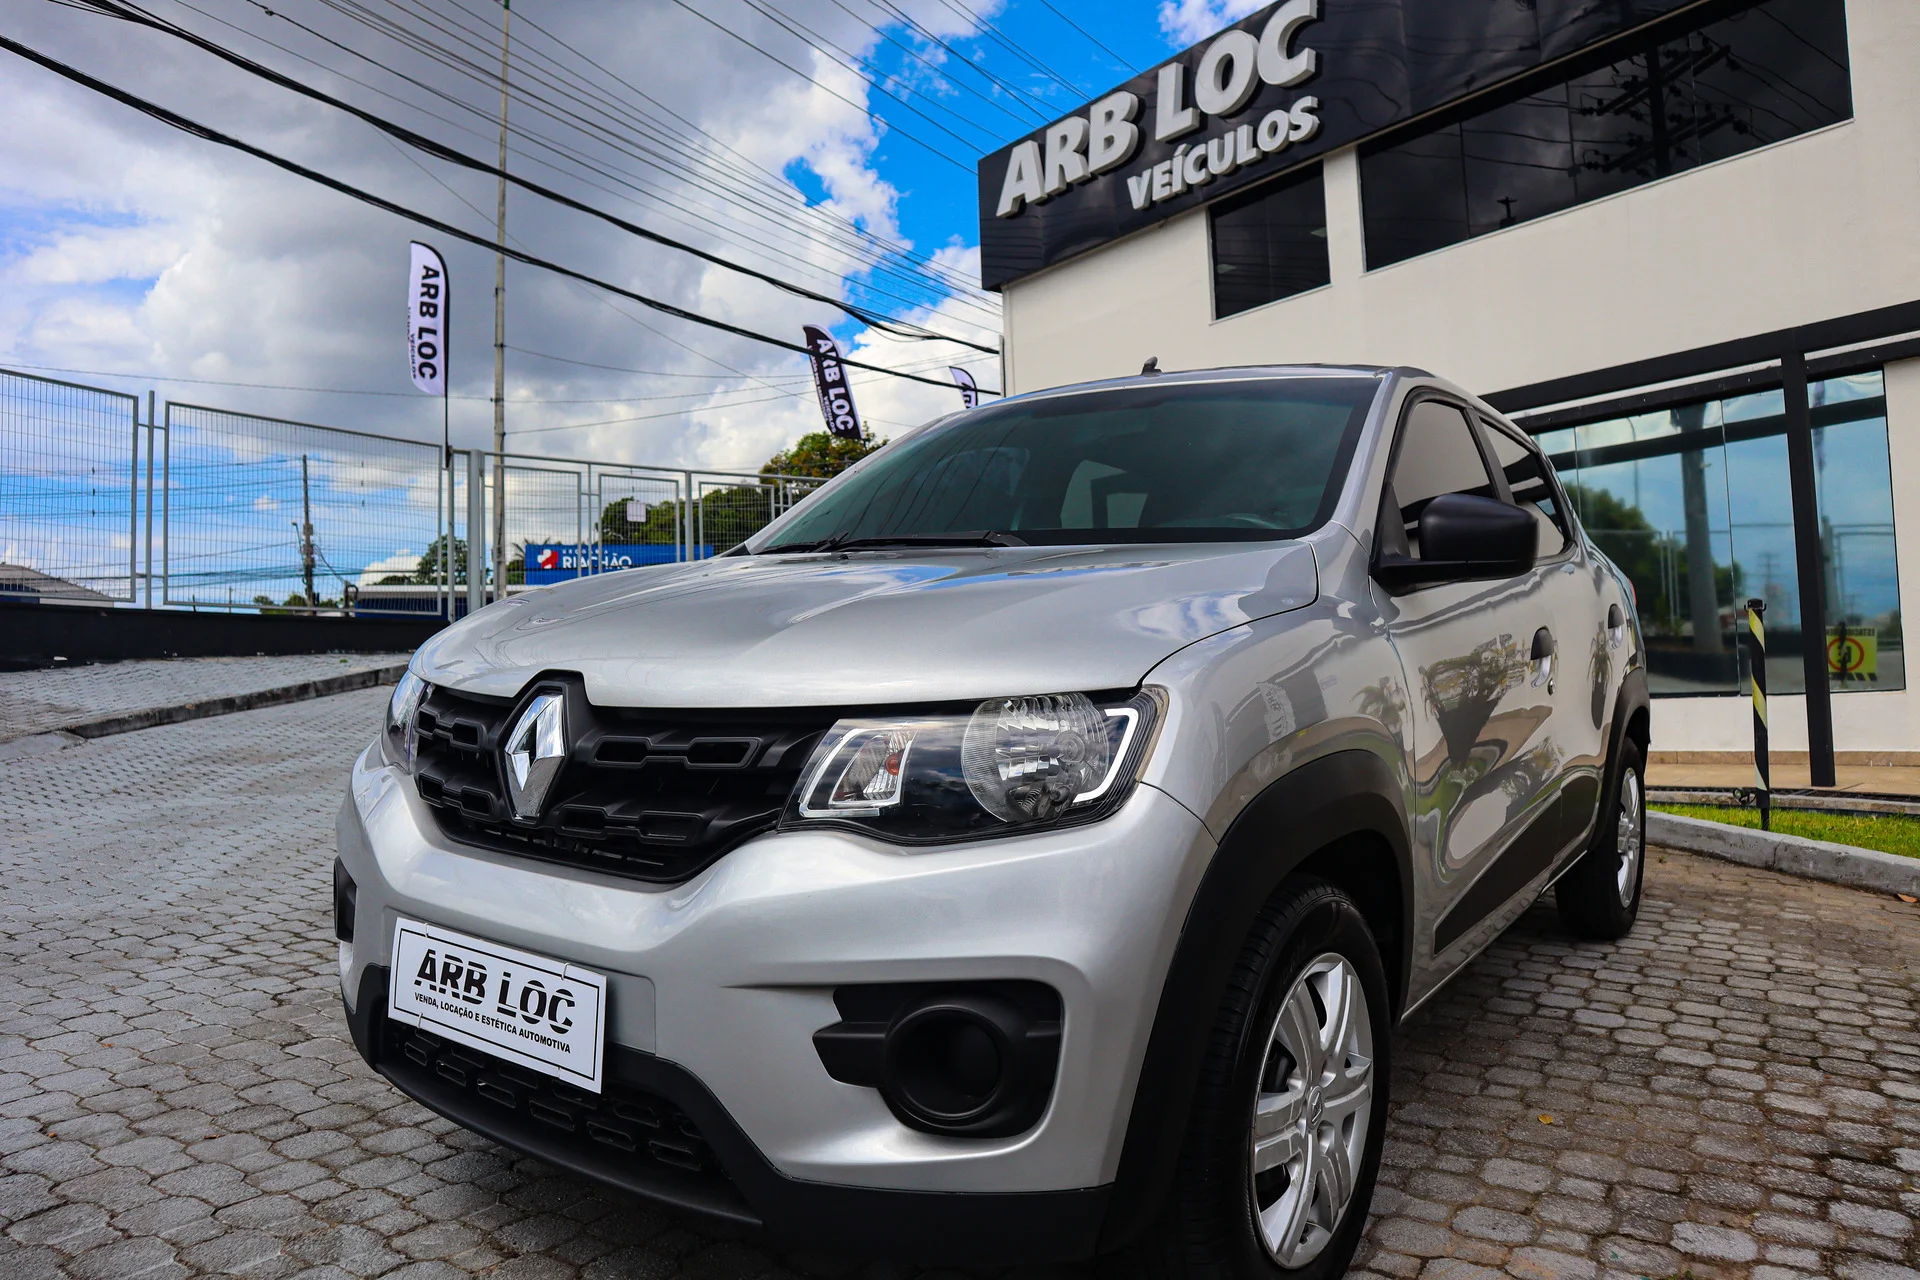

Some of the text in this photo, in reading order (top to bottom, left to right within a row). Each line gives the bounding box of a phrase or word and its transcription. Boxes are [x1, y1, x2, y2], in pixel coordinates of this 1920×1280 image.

[996, 0, 1318, 217] ARB LOC
[1127, 96, 1320, 210] VEÍCULOS
[417, 265, 440, 380] ARB LOC
[828, 387, 855, 430] LOC
[414, 949, 576, 1034] ARB LOC
[414, 992, 571, 1053] VENDA, LOCAÇÃO E ESTÉTICA AUTOMOTIVA
